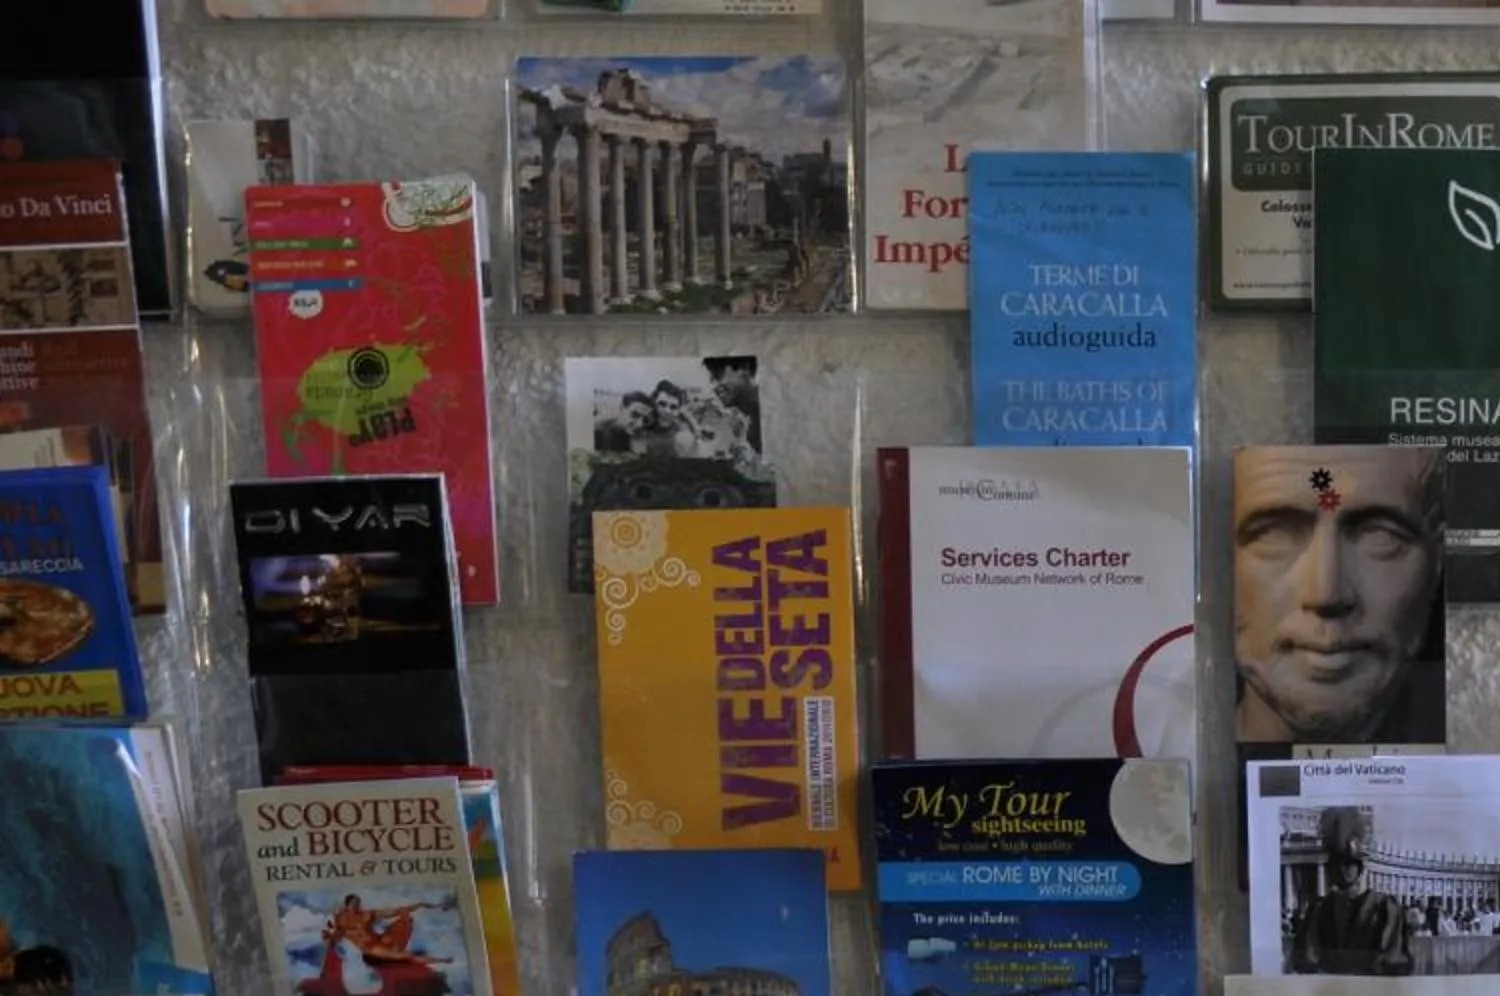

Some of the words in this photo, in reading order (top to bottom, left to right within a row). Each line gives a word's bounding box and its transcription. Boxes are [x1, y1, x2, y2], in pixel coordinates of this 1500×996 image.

[20, 195, 51, 217] Da
[59, 193, 112, 217] Vinci
[1028, 264, 1105, 287] TERME
[1112, 264, 1139, 286] DI
[1000, 290, 1169, 318] CARACALLA
[1011, 321, 1157, 352] audioguida
[1003, 380, 1049, 402] THE
[1056, 380, 1132, 402] BATHS
[1137, 380, 1171, 402] OF
[1002, 407, 1169, 434] CARACALLA
[1446, 449, 1470, 463] del
[941, 546, 1039, 568] Services
[1045, 546, 1131, 568] Charter
[974, 571, 1031, 586] Museum
[1105, 571, 1145, 586] Rome
[711, 535, 766, 691] DELLA
[765, 528, 836, 691] SETA
[717, 696, 801, 833] VIE
[1334, 762, 1354, 776] del
[1356, 762, 1406, 776] Vaticano
[257, 797, 444, 832] SCOOTER
[901, 784, 969, 829] My
[979, 779, 1072, 818] Tour
[970, 815, 1088, 839] sightseeing
[257, 837, 300, 859] and
[307, 825, 456, 857] BICYCLE
[266, 861, 355, 882] RENTAL
[382, 857, 458, 876] TOURS
[962, 865, 1024, 885] ROME
[1029, 865, 1052, 885] BY
[1058, 865, 1120, 885] NIGHT
[913, 912, 934, 926] The
[937, 912, 966, 930] price
